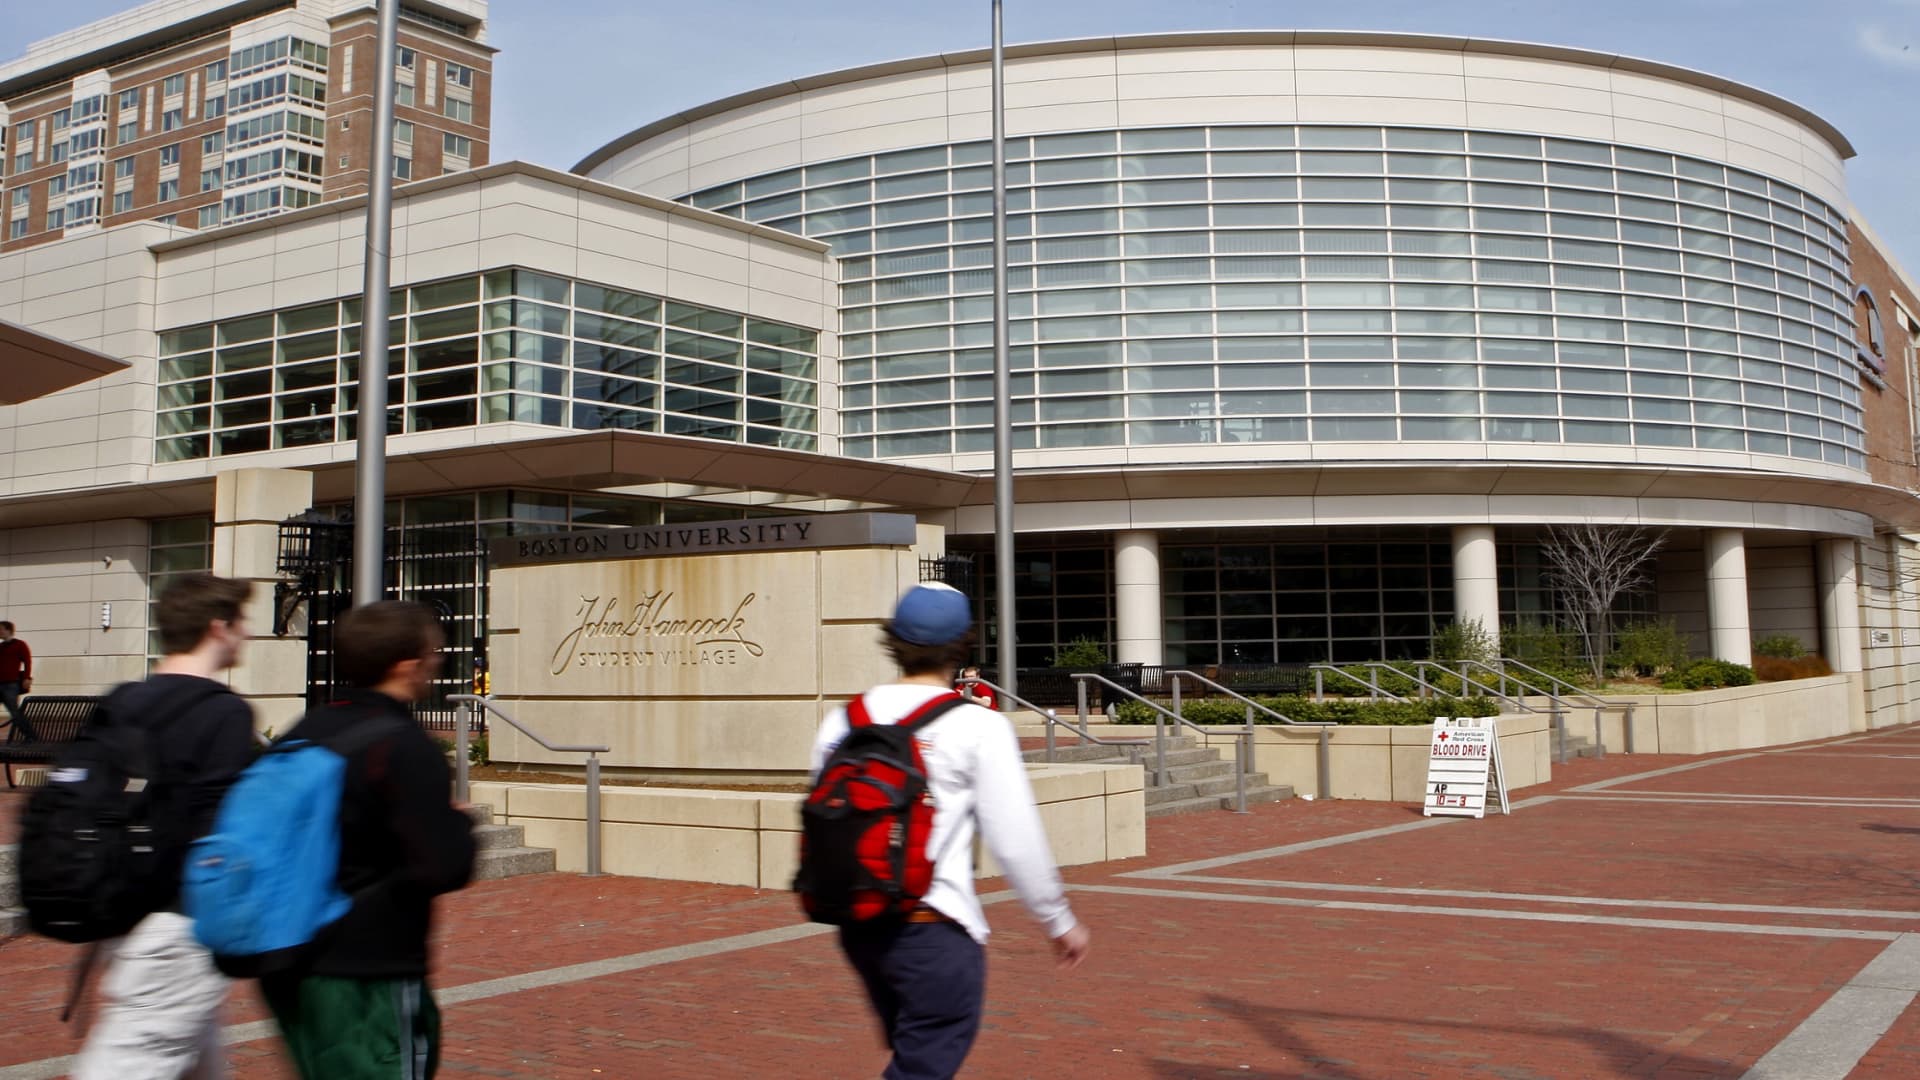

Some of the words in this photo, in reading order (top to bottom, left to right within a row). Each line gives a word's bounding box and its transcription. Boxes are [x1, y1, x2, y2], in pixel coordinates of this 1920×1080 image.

[519, 534, 609, 558] BOSTON
[624, 521, 812, 550] UNIVERSITY
[551, 595, 624, 676] John
[622, 589, 764, 657] Hancock
[578, 652, 654, 667] STUDENT
[659, 650, 737, 666] VILLAGE
[1433, 744, 1460, 756] BLOOD
[1462, 744, 1487, 756] DRIVE
